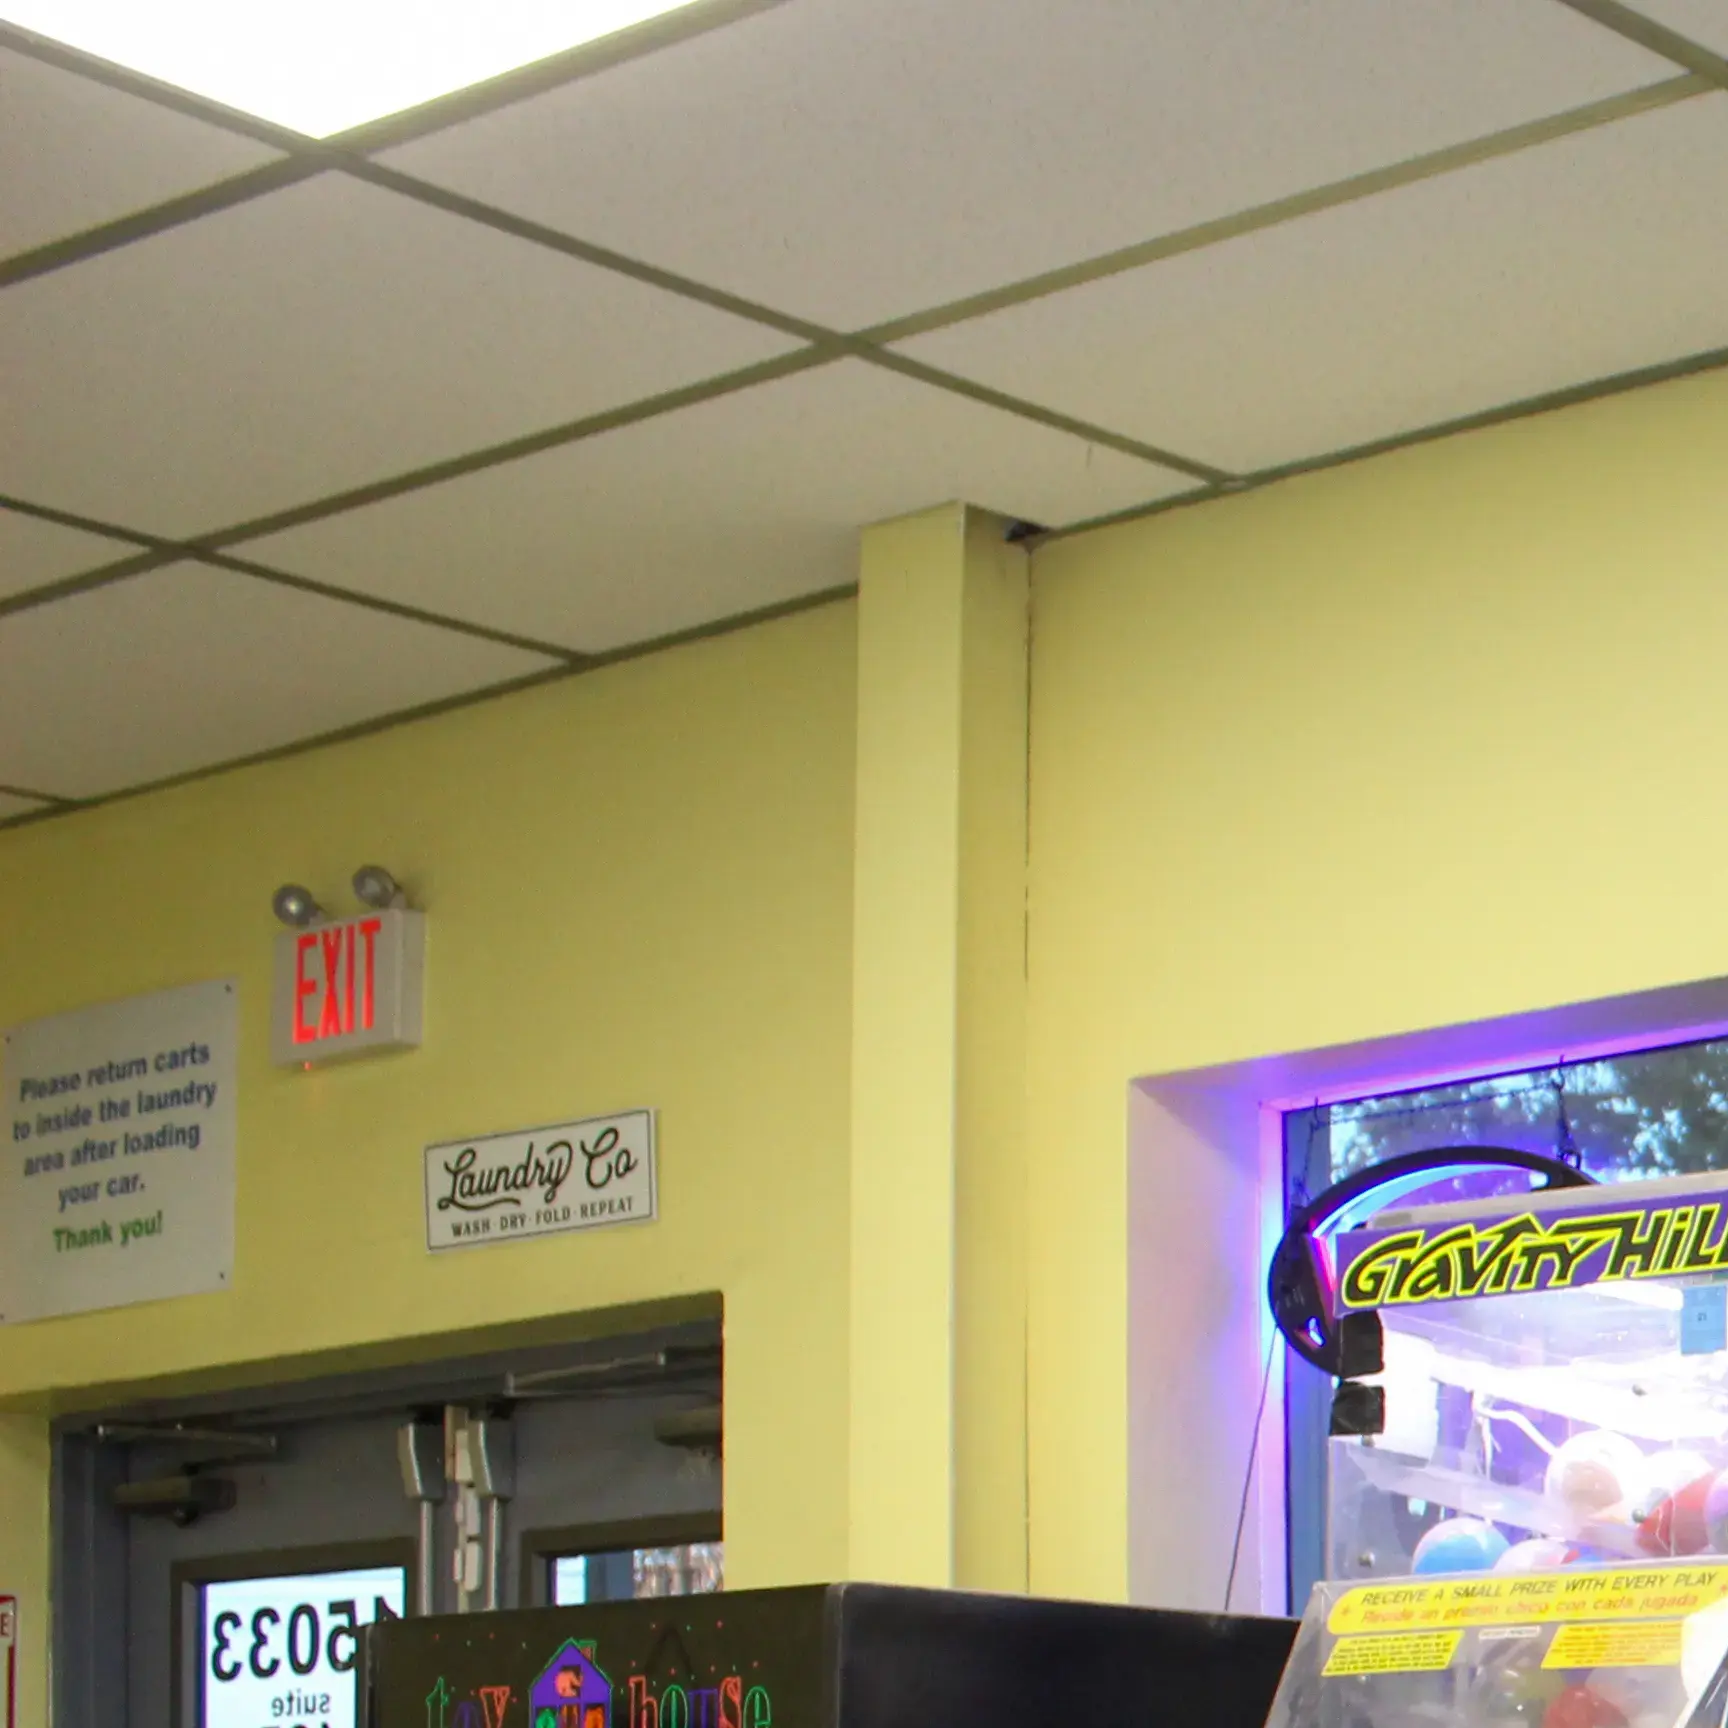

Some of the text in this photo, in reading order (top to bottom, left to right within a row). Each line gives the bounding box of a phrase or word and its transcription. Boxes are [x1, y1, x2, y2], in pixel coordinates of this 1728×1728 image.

[293, 917, 381, 1045] EXIT
[20, 1041, 210, 1102] Please return carts
[13, 1080, 217, 1144] to inside the laundry
[24, 1122, 200, 1177] area after loading
[437, 1126, 638, 1211] Laundry Co
[59, 1173, 145, 1212] your car.
[452, 1196, 633, 1237] WASH DRY FOLD REPEAT
[53, 1209, 163, 1253] Thank you!
[1450, 1582, 1502, 1601] SMALL
[1511, 1578, 1556, 1596] PRIZE
[1564, 1576, 1606, 1593] WITH
[1612, 1573, 1665, 1591] EVERY
[1673, 1571, 1718, 1588] PLAY
